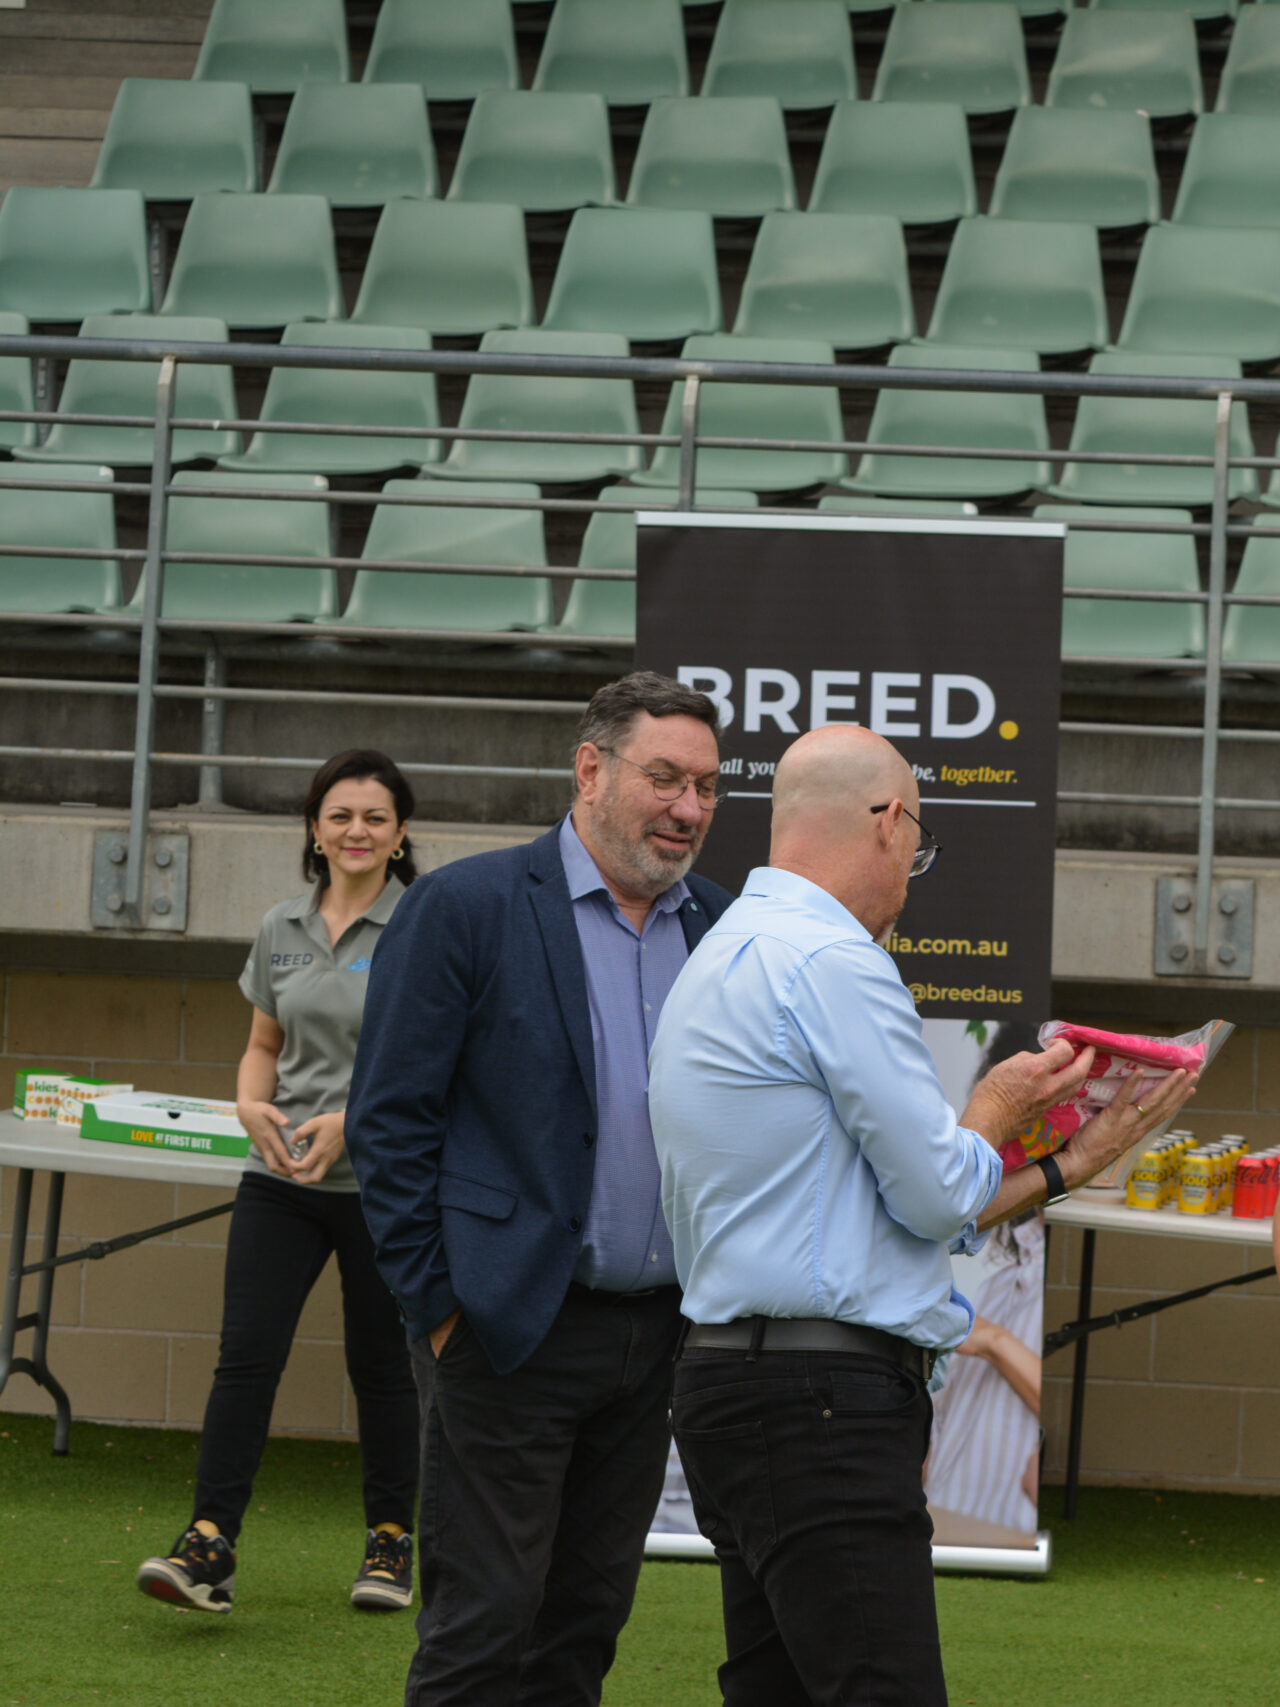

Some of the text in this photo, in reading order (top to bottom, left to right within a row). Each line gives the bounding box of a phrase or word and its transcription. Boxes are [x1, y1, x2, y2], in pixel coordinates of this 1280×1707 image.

[677, 665, 1019, 740] BREED.
[719, 758, 743, 775] all
[940, 764, 1018, 787] together.
[884, 932, 1008, 956] lia.com.au
[908, 983, 1023, 1004] @breedaus
[130, 1128, 154, 1143] LOVE
[164, 1133, 190, 1148] FIRST
[191, 1137, 212, 1150] BITE
